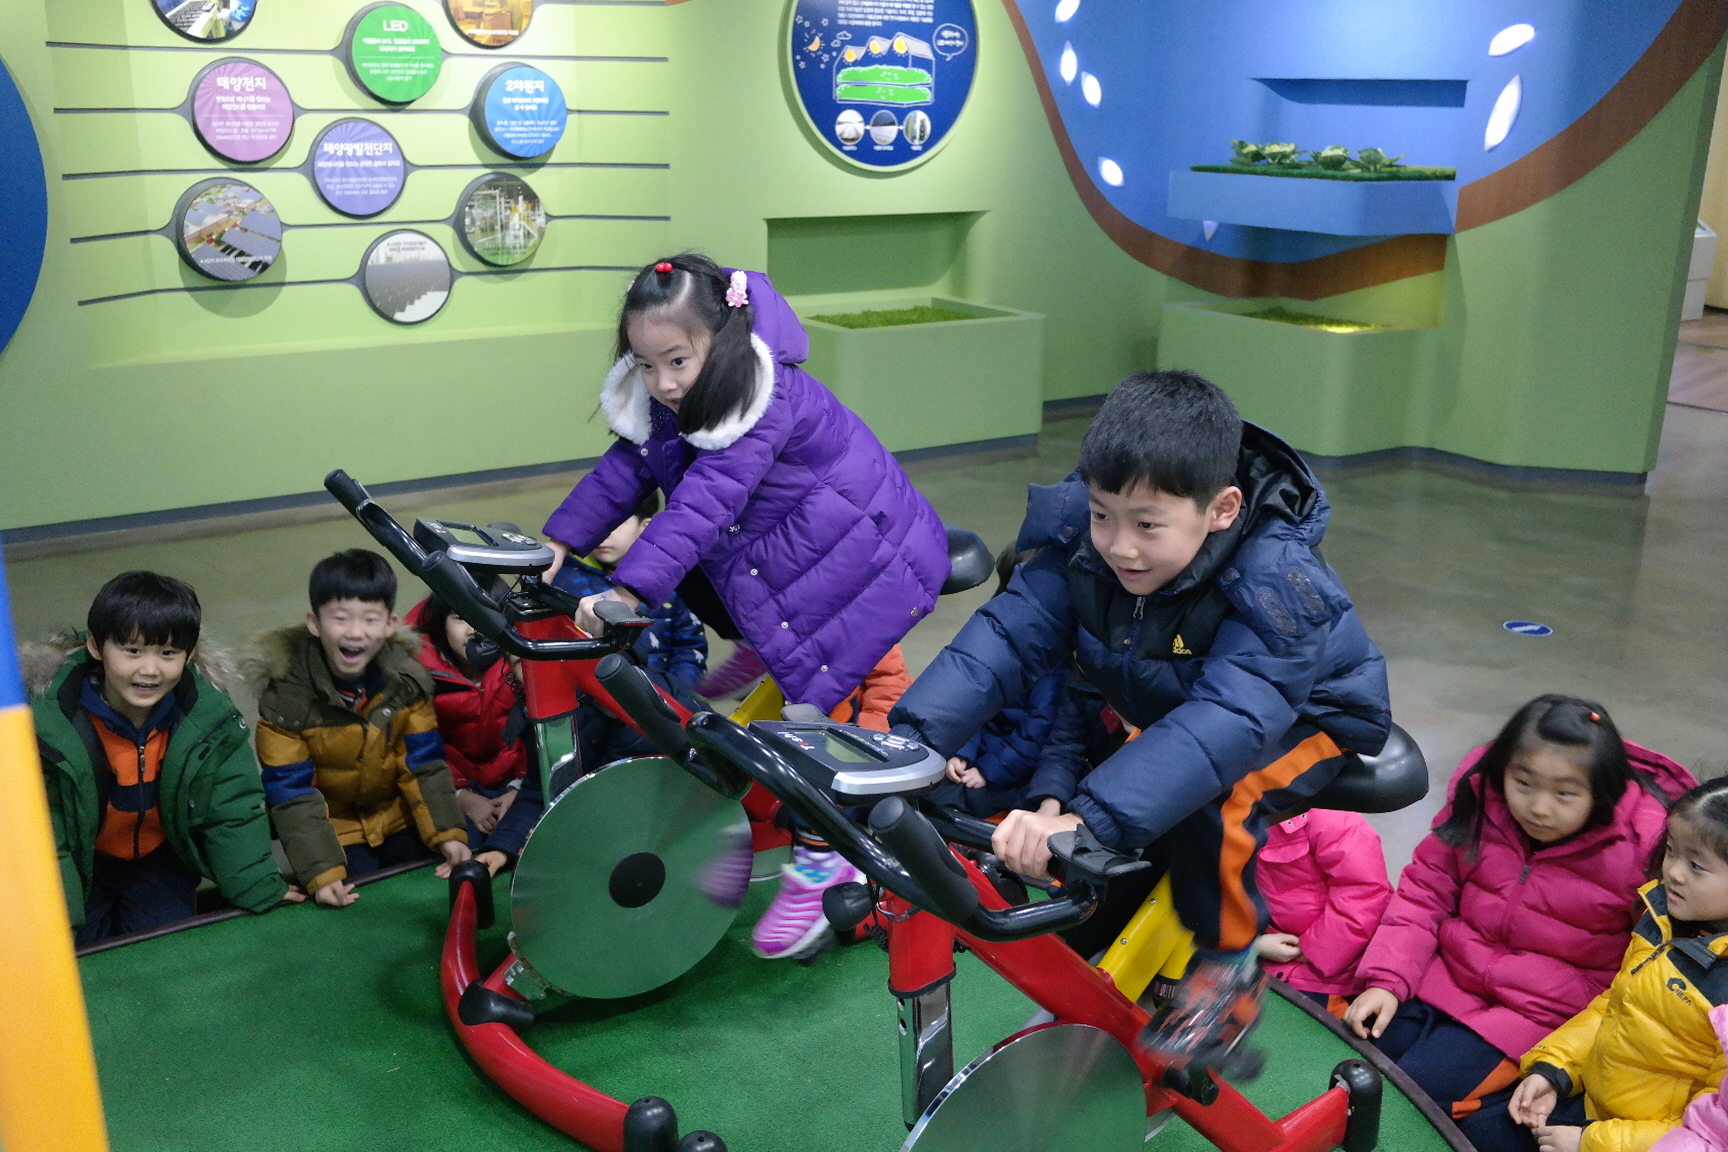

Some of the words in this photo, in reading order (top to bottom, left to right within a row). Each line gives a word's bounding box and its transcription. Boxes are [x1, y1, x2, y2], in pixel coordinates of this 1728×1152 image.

[383, 20, 409, 31] LED
[216, 76, 267, 92] 태양전지
[505, 79, 545, 94] 2차전지
[323, 142, 393, 156] 태양광발전단지
